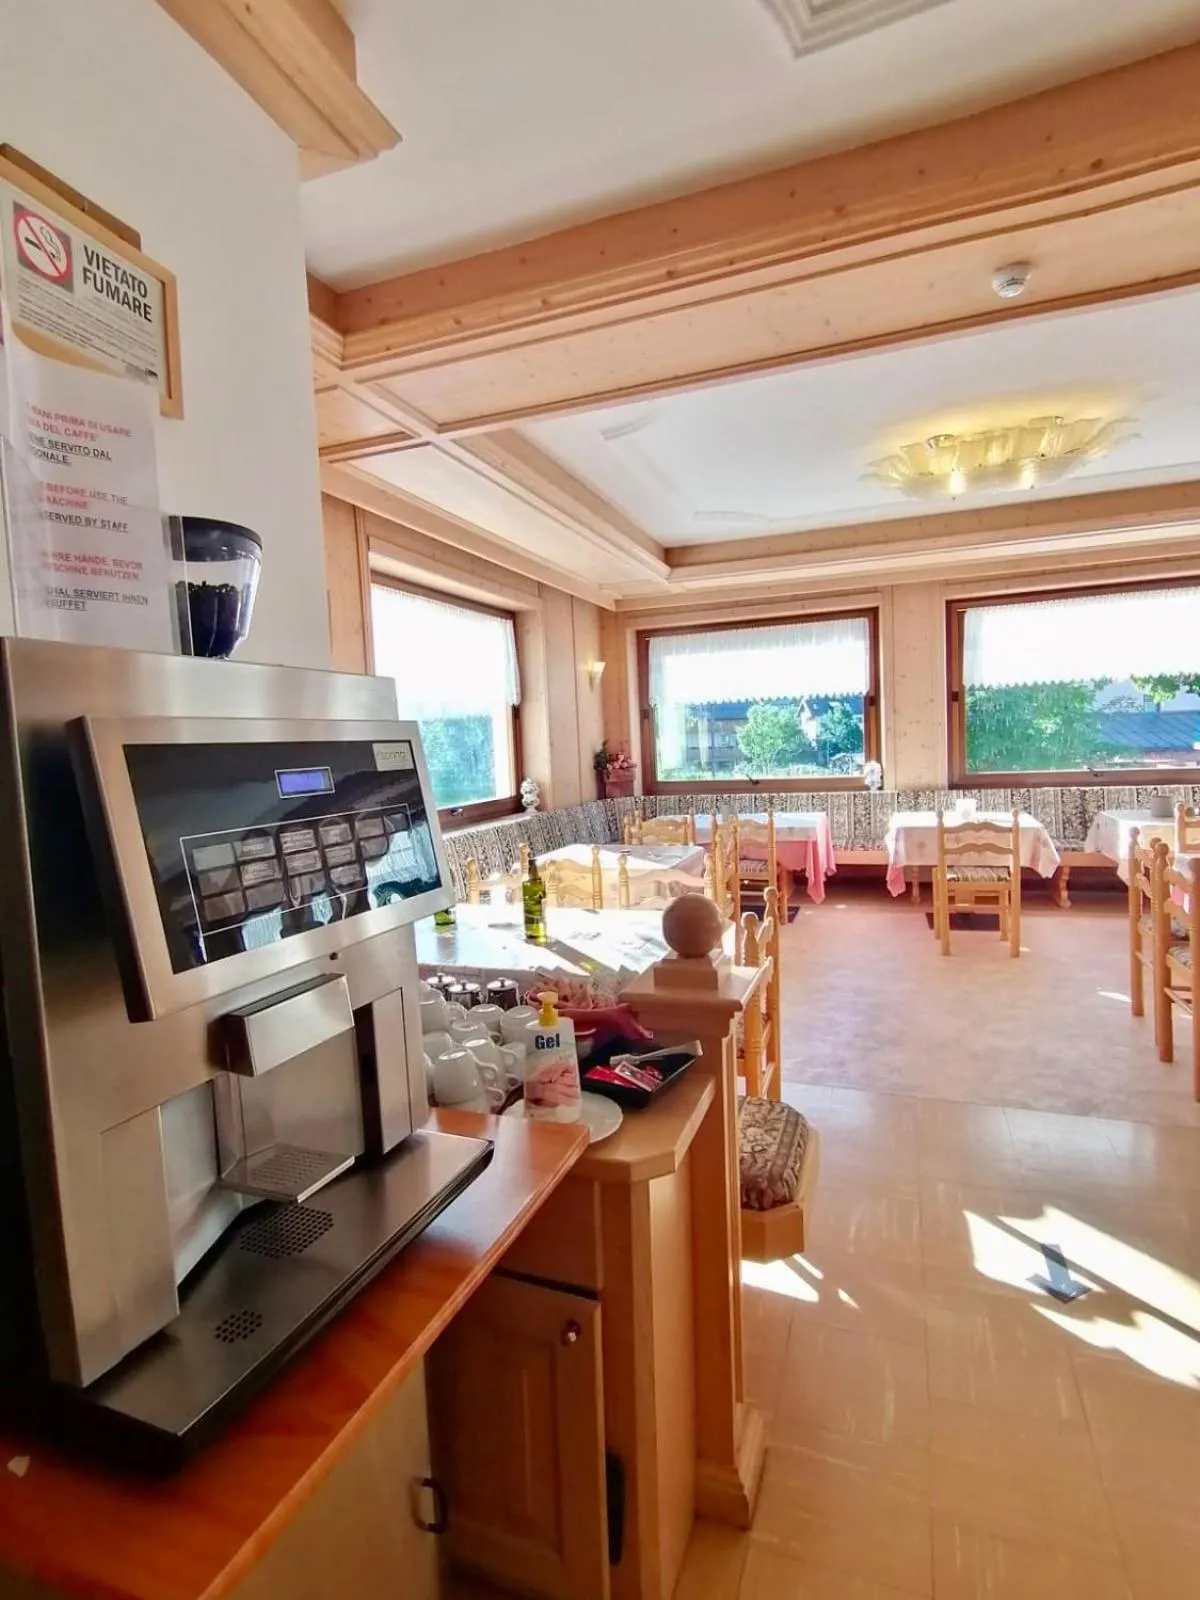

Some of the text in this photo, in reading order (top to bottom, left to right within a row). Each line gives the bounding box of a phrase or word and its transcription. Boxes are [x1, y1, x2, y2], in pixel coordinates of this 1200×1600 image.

[83, 244, 148, 299] VIETATO
[83, 268, 152, 323] FUMARE
[43, 423, 61, 436] DEL
[48, 439, 91, 456] SERVITO
[93, 448, 111, 461] DAL
[89, 488, 108, 501] USE
[110, 493, 128, 506] THE
[85, 516, 98, 528] BY
[100, 519, 129, 532] STAFF
[73, 588, 120, 601] SERVIERT
[534, 1033, 560, 1050] Gel
